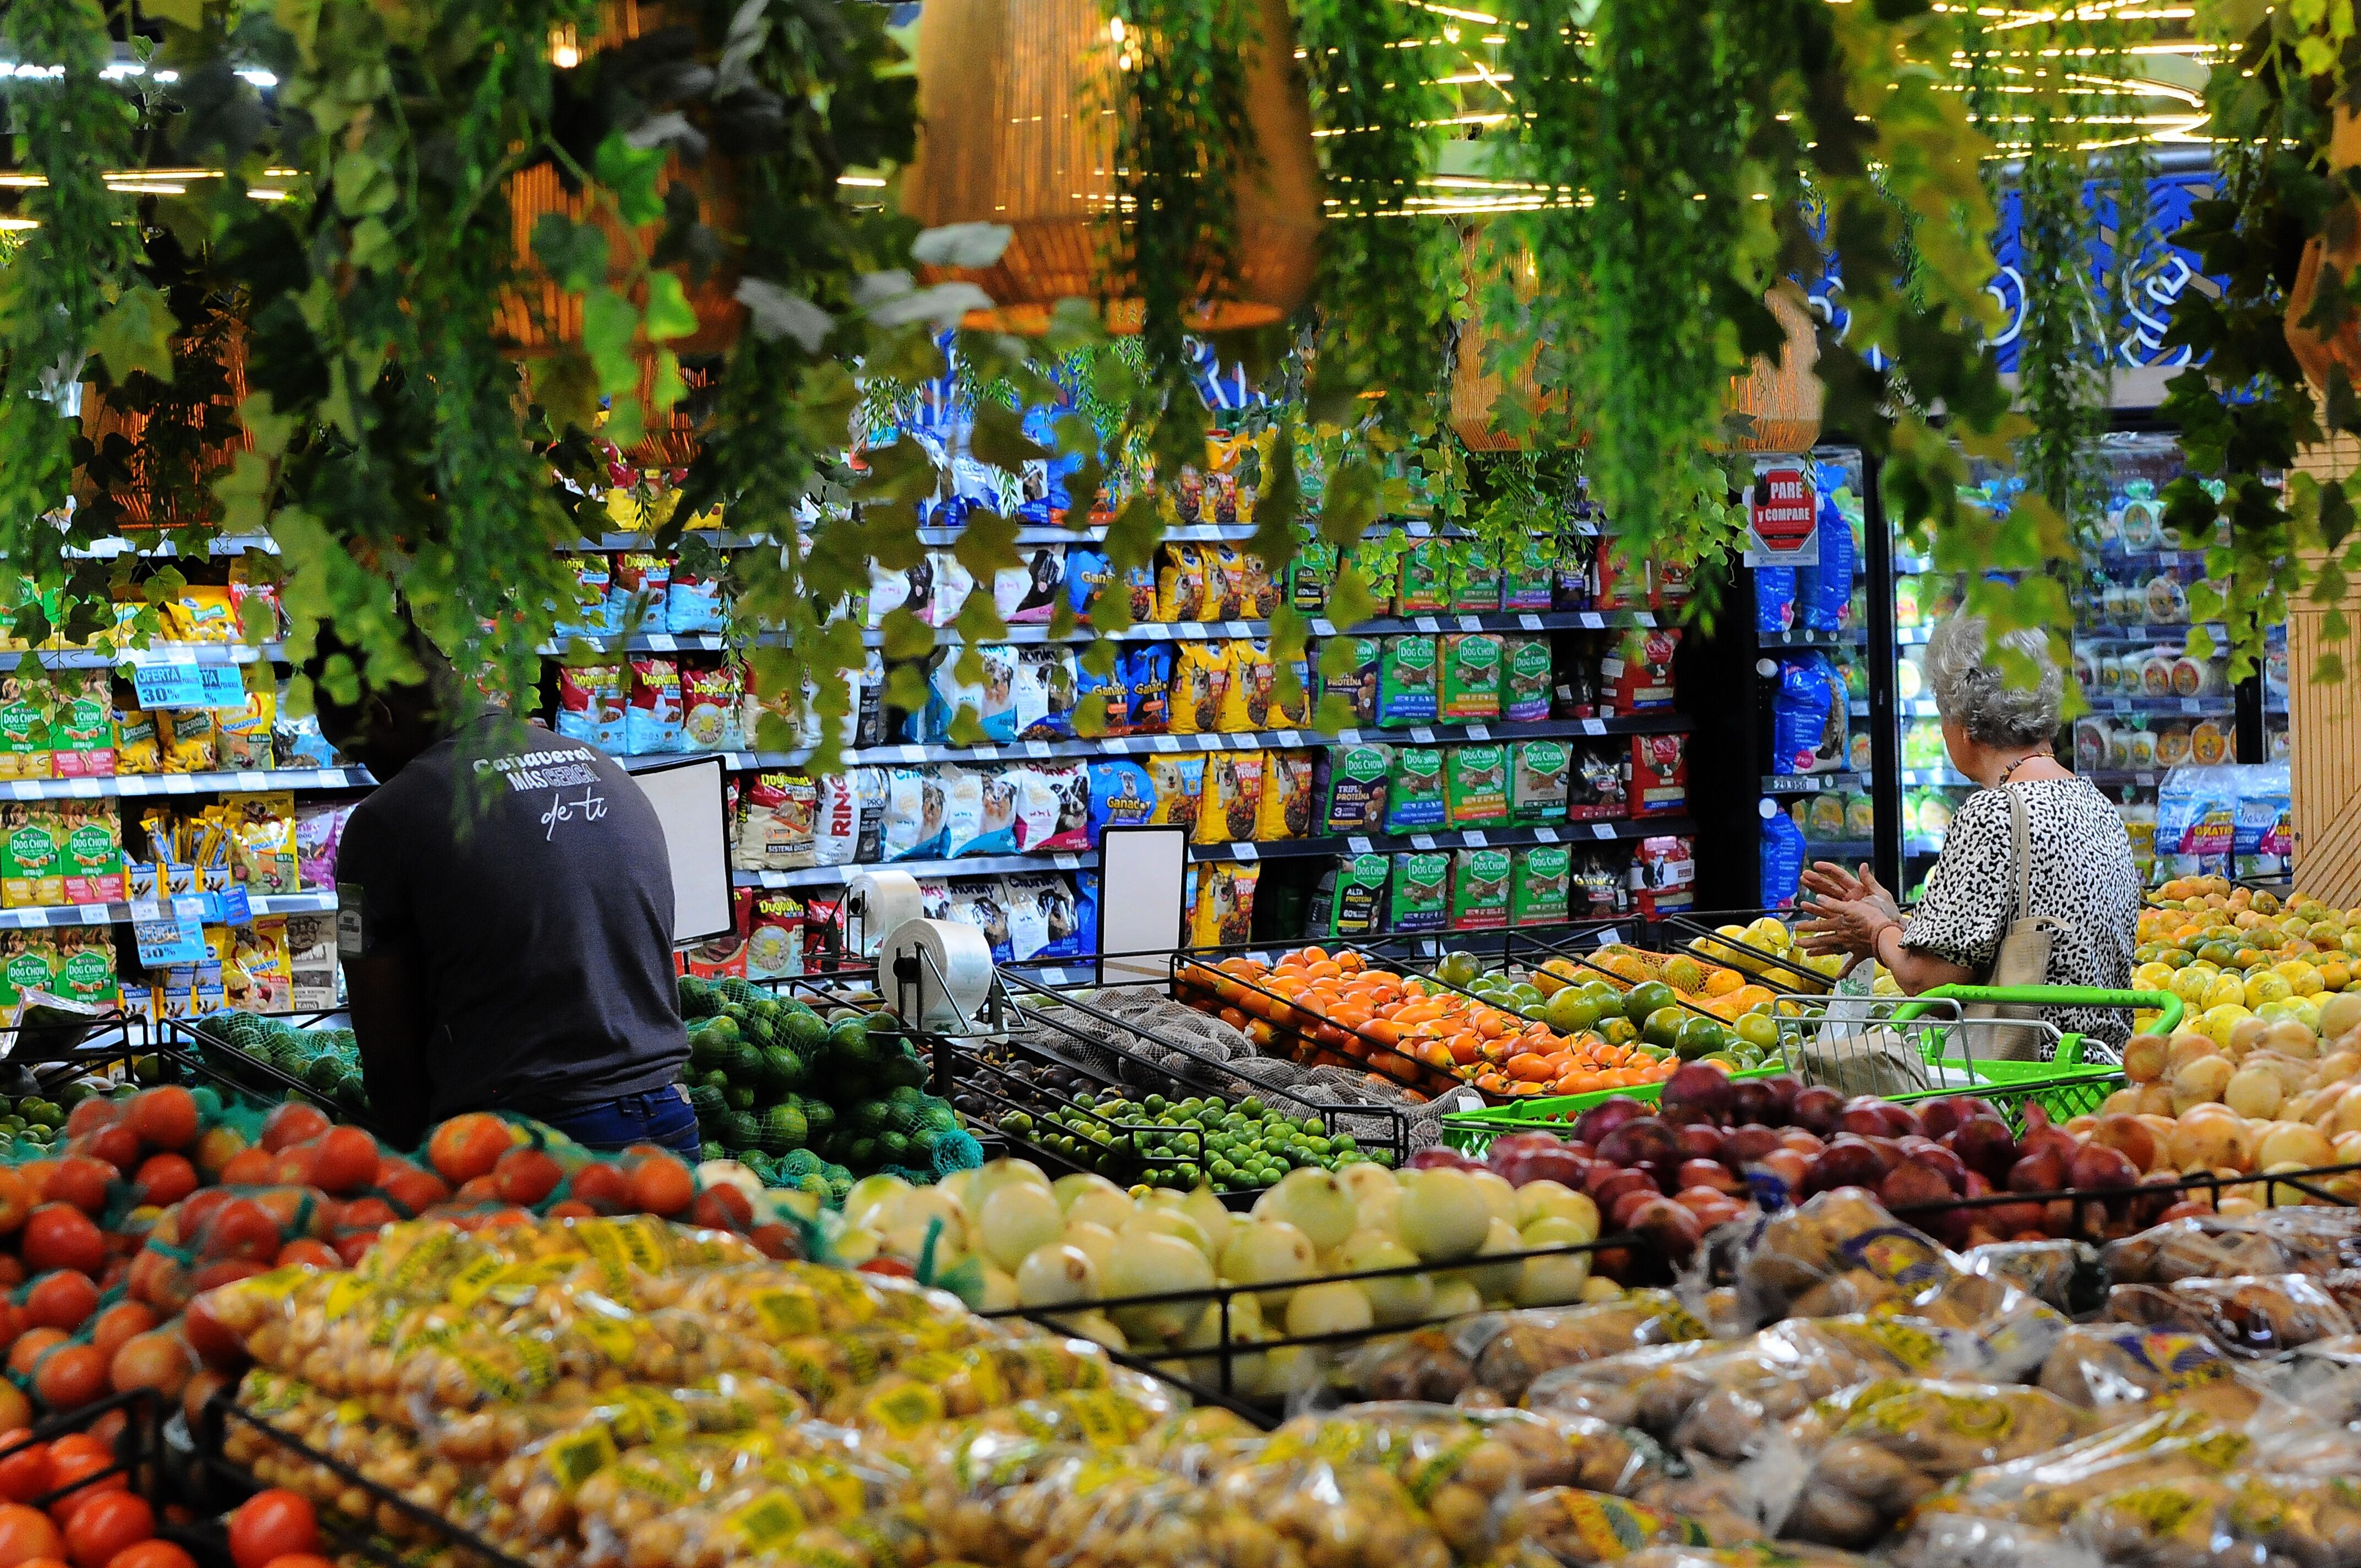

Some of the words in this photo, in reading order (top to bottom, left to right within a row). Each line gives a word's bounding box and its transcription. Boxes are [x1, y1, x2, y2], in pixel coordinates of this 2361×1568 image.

[1771, 482, 1802, 499] PARE
[1765, 508, 1810, 521] COMPARE
[1401, 647, 1416, 656] DOG
[1462, 647, 1476, 656] DOG
[1477, 646, 1495, 656] CHOW
[1517, 657, 1530, 666] DOG
[139, 667, 181, 683] OFERTA
[142, 689, 179, 703] 30%
[4, 715, 18, 724] DOG
[80, 713, 100, 722] CHOW
[222, 717, 262, 732] BOCADITOS
[1463, 749, 1476, 759] DOG
[1477, 749, 1497, 759] CHOW
[1528, 753, 1542, 762] DOG
[1542, 750, 1563, 761] CHOW
[474, 747, 596, 773] Cañaveral
[1407, 755, 1421, 764] DOG
[1349, 761, 1362, 770] DOG
[1363, 760, 1383, 770] CHOW
[507, 768, 548, 791] MÁS
[542, 764, 601, 787] CERCA
[867, 798, 883, 807] PRO
[541, 793, 573, 841] de
[1334, 807, 1342, 817] 3
[2194, 826, 2233, 836] GRATIS
[13, 840, 28, 848] DOG
[29, 839, 49, 848] CHOW
[73, 839, 87, 848] DOG
[88, 837, 108, 847] CHOW
[768, 844, 793, 852] SISTEMA
[1474, 861, 1487, 870] DOG
[1488, 860, 1506, 870] CHOW
[1532, 858, 1547, 867] DOG
[1547, 857, 1565, 867] CHOW
[1357, 865, 1370, 875] DOG
[1412, 864, 1427, 874] DOG
[1347, 888, 1363, 896] ALTA
[141, 948, 176, 959] 30%
[10, 968, 24, 977] DOG
[26, 966, 45, 976] CHOW
[69, 965, 83, 974] DOG
[84, 964, 105, 973] CHOW
